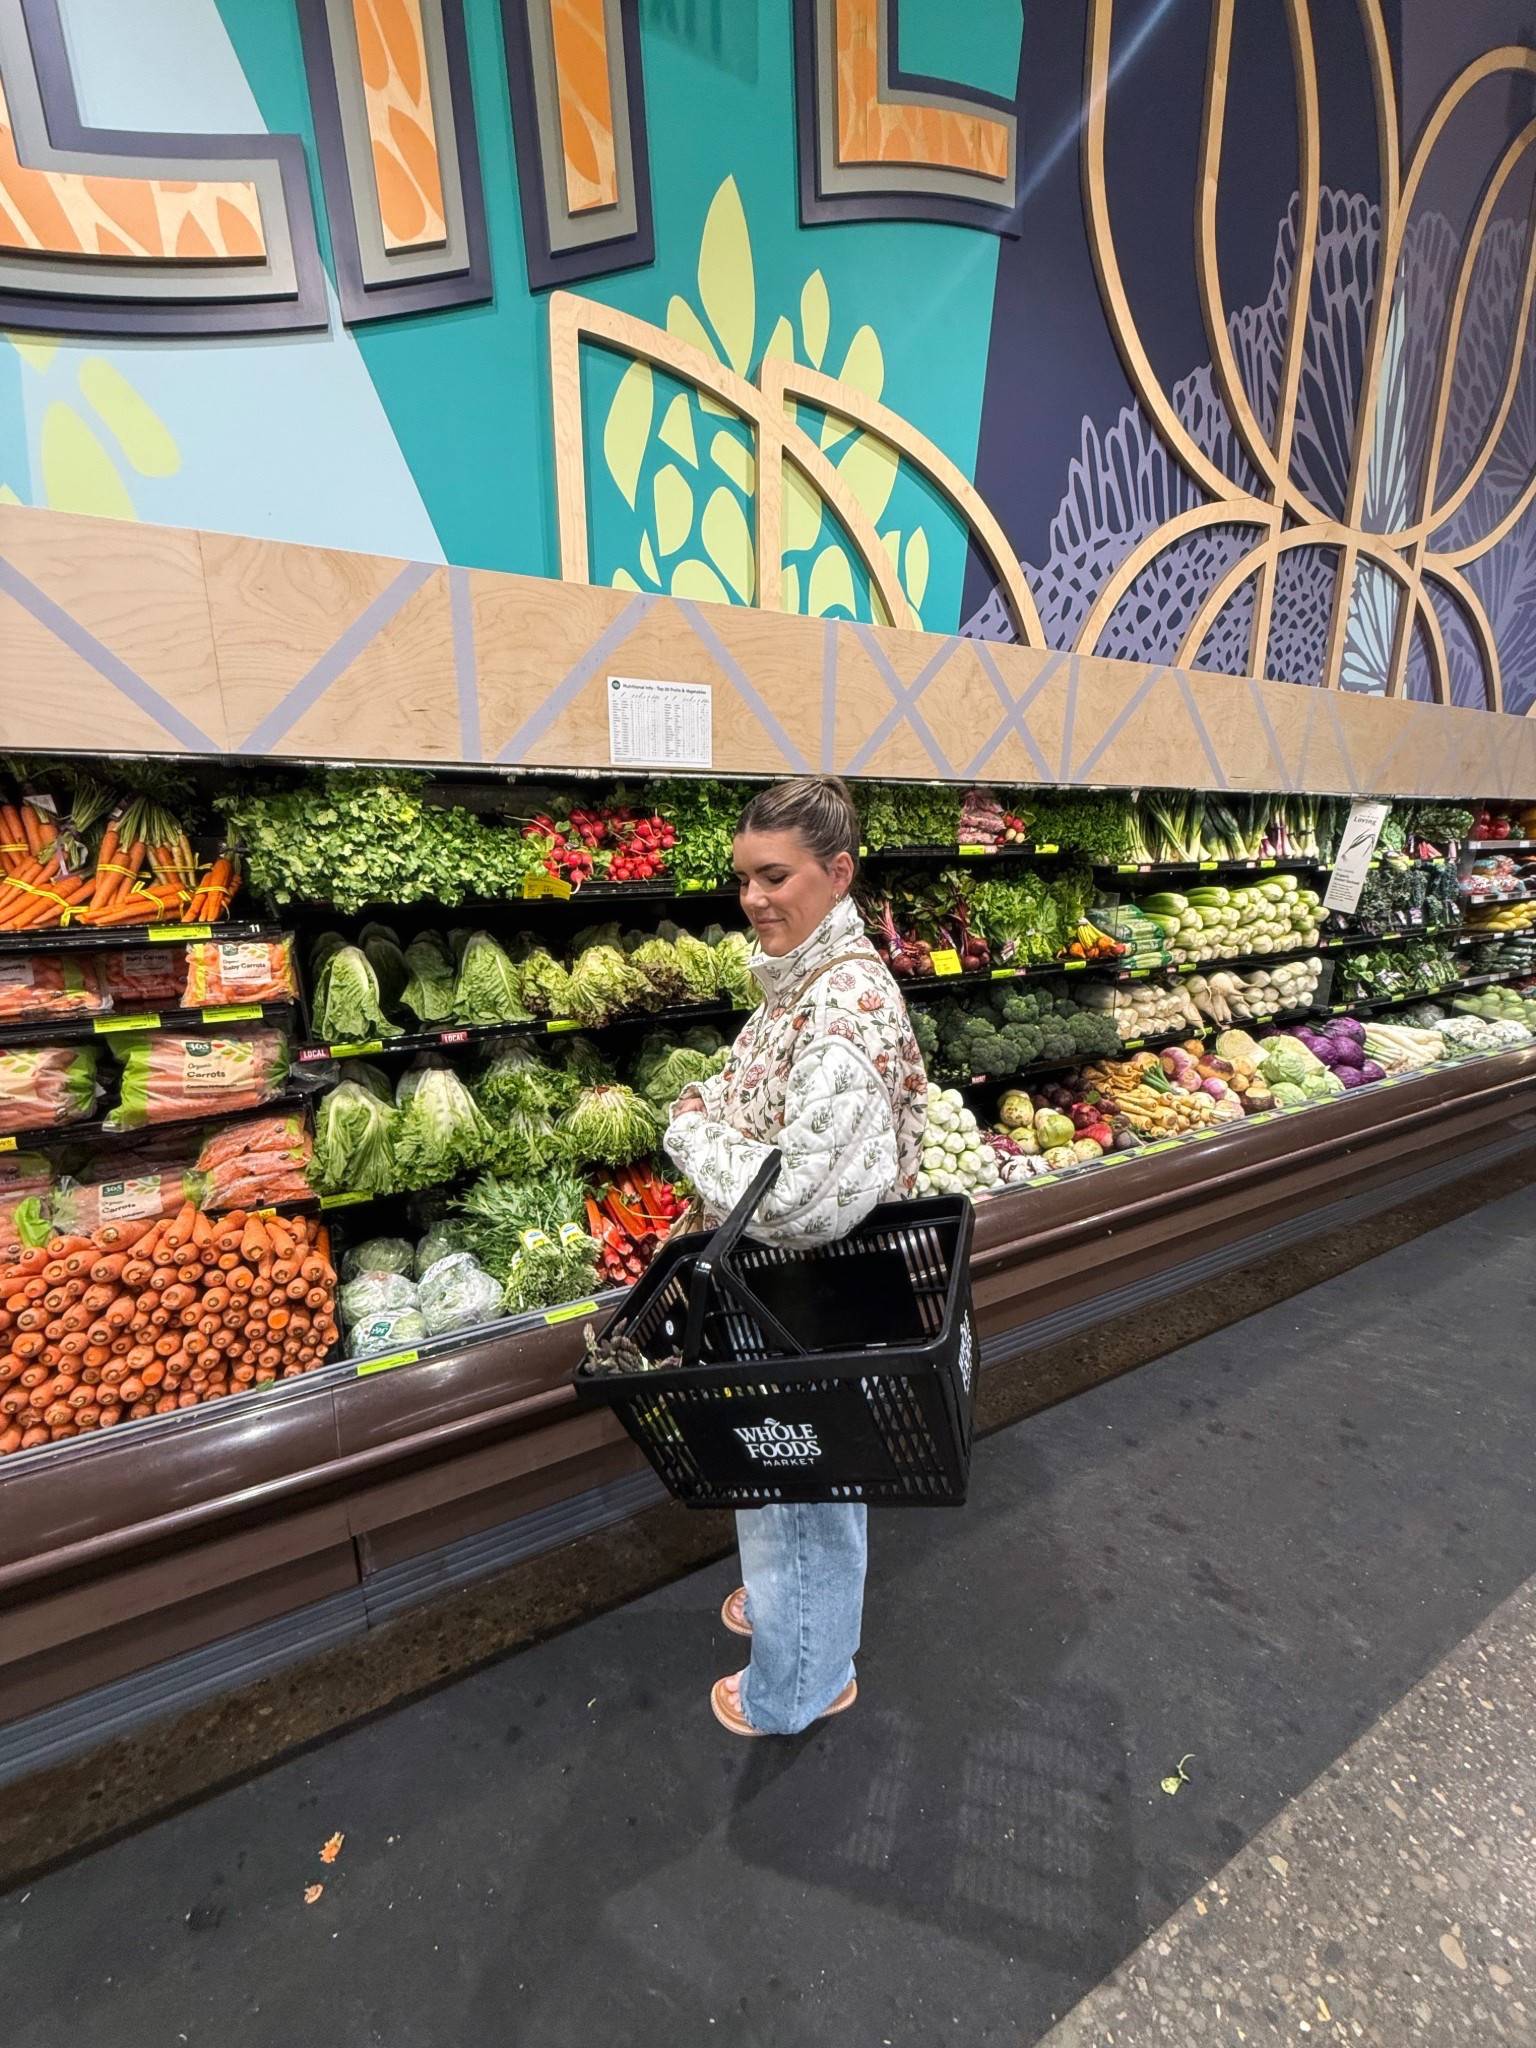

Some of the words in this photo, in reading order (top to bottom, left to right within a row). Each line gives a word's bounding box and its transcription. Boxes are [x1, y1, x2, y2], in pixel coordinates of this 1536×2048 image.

[1354, 816, 1377, 826] Loving
[250, 924, 261, 932] 11
[444, 1033, 464, 1043] LOCAL
[303, 1049, 326, 1059] LOCAL
[186, 1070, 226, 1078] Carrots
[102, 1203, 137, 1214] Carrots
[733, 1422, 817, 1443] WHOLE
[746, 1440, 822, 1459] FOODS
[763, 1458, 815, 1467] MARKET
